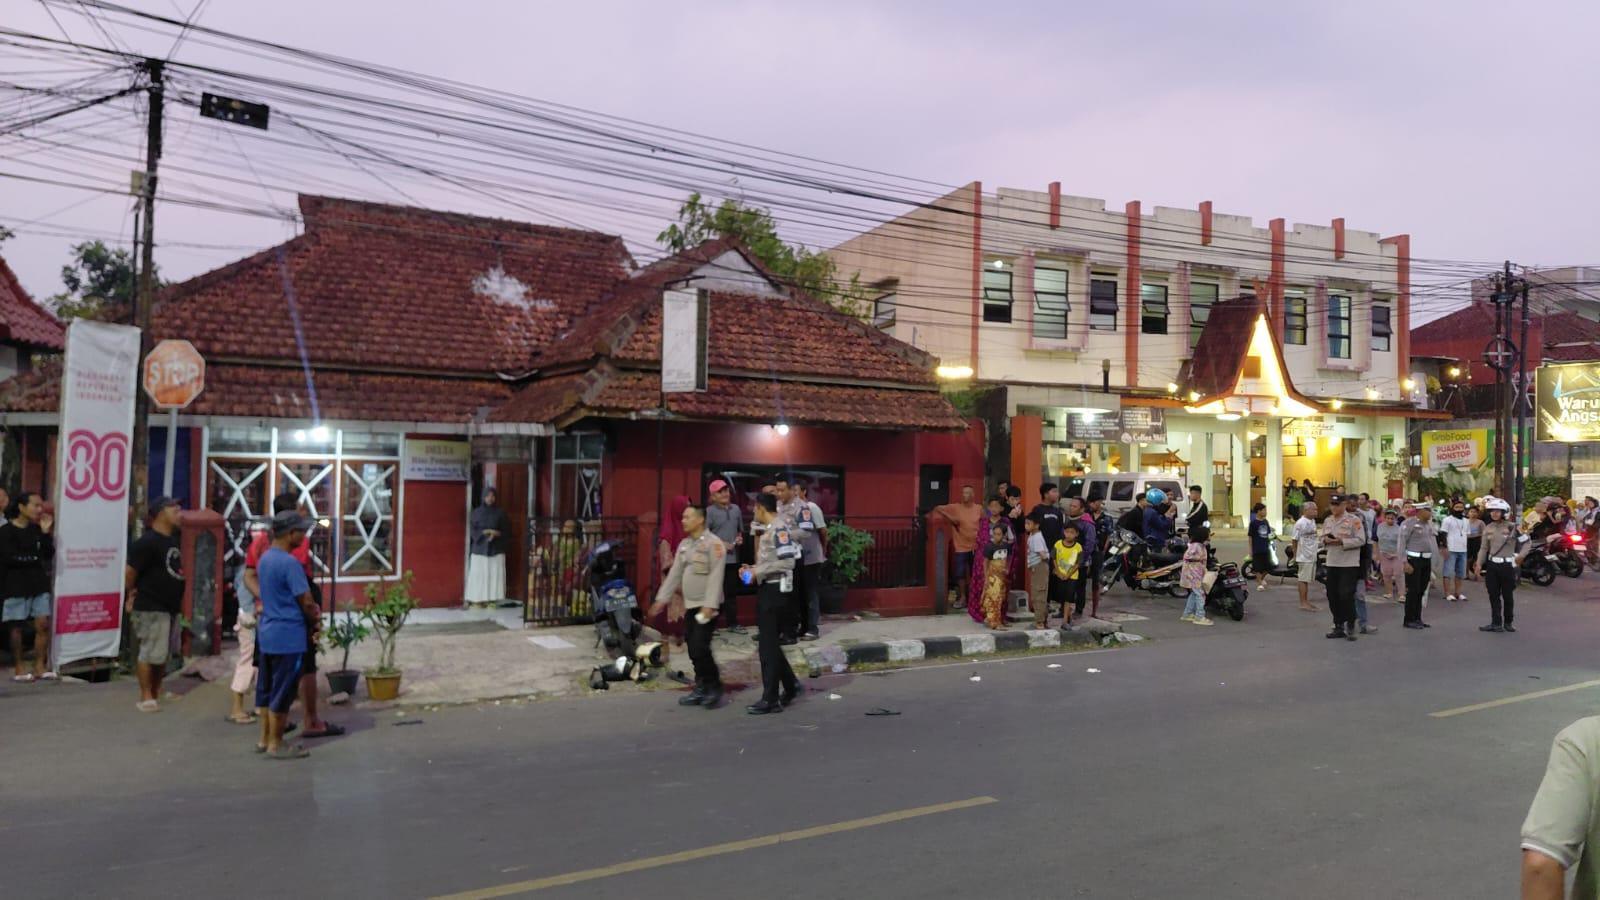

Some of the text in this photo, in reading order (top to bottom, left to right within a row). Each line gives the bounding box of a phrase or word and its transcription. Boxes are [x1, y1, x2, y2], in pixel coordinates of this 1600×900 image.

[150, 362, 200, 386] STOP
[1559, 409, 1600, 425] Angs
[1431, 432, 1472, 441] GrabFood
[1436, 441, 1471, 453] PUASNYA
[1436, 450, 1472, 461] NONSTOP
[65, 429, 128, 501] 80
